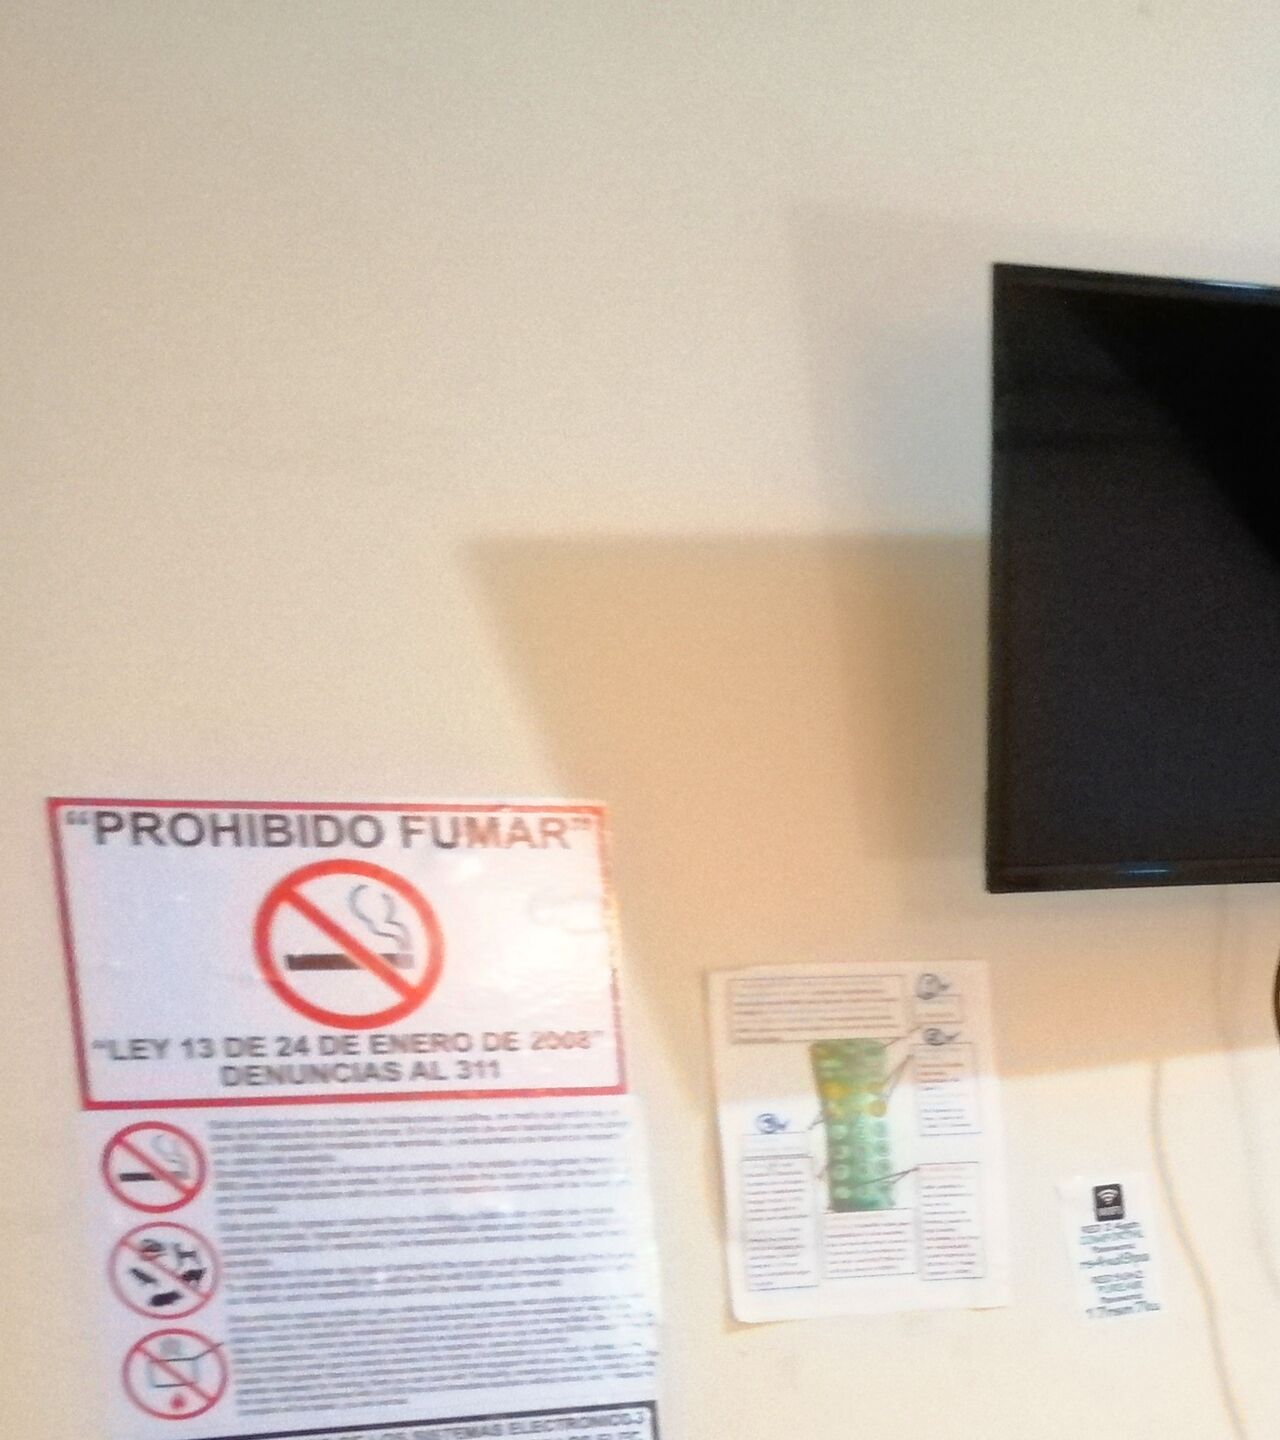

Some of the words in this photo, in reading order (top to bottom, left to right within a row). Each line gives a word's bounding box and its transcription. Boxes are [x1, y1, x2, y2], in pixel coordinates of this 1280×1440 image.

[181, 1038, 215, 1059] 13
[222, 1035, 267, 1057] DE
[275, 1035, 311, 1057] 24
[319, 1034, 361, 1056] DE
[368, 1032, 474, 1054] ENERO
[482, 1030, 521, 1052] DE
[219, 1060, 403, 1087] DENUNCIAS
[408, 1060, 448, 1082] AL
[457, 1058, 502, 1081] 311
